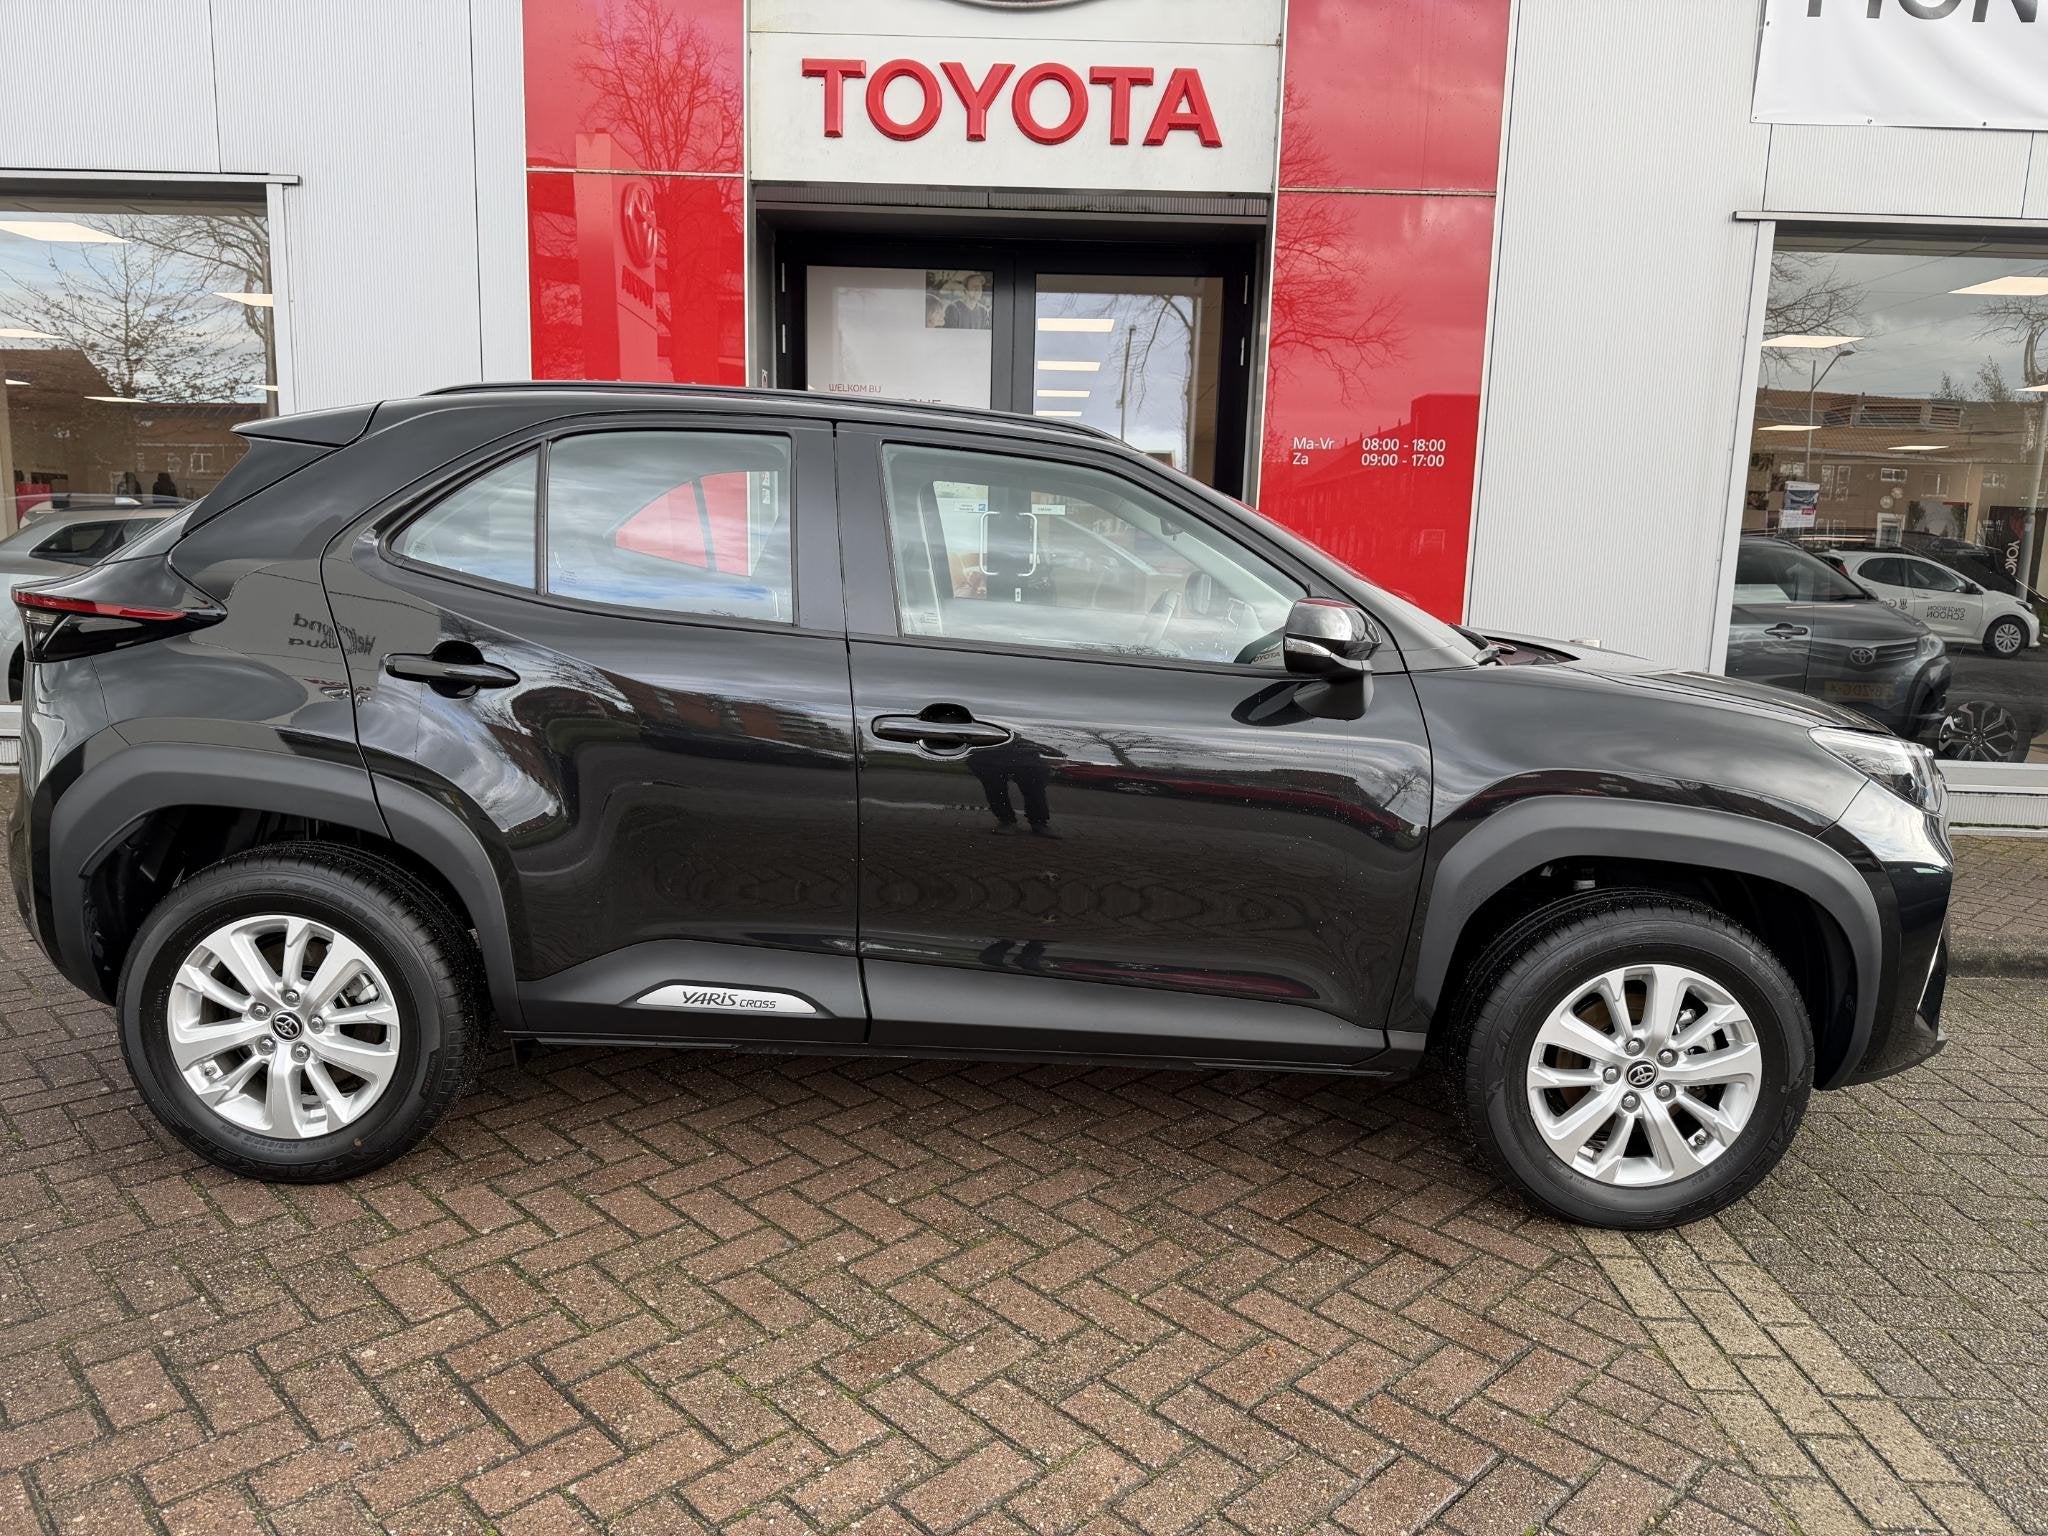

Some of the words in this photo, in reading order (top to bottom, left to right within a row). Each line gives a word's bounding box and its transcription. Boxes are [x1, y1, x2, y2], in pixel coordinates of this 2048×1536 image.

[801, 58, 1223, 148] TOYOTA
[828, 383, 867, 393] WELKOM
[1293, 436, 1335, 450] Ma-Vr
[1362, 438, 1400, 451] 08:00
[1412, 438, 1446, 452] 18:00
[1292, 452, 1309, 465] Za
[1361, 453, 1398, 467] 09:00
[1412, 454, 1445, 467] 17:00
[739, 999, 776, 1009] CROSS
